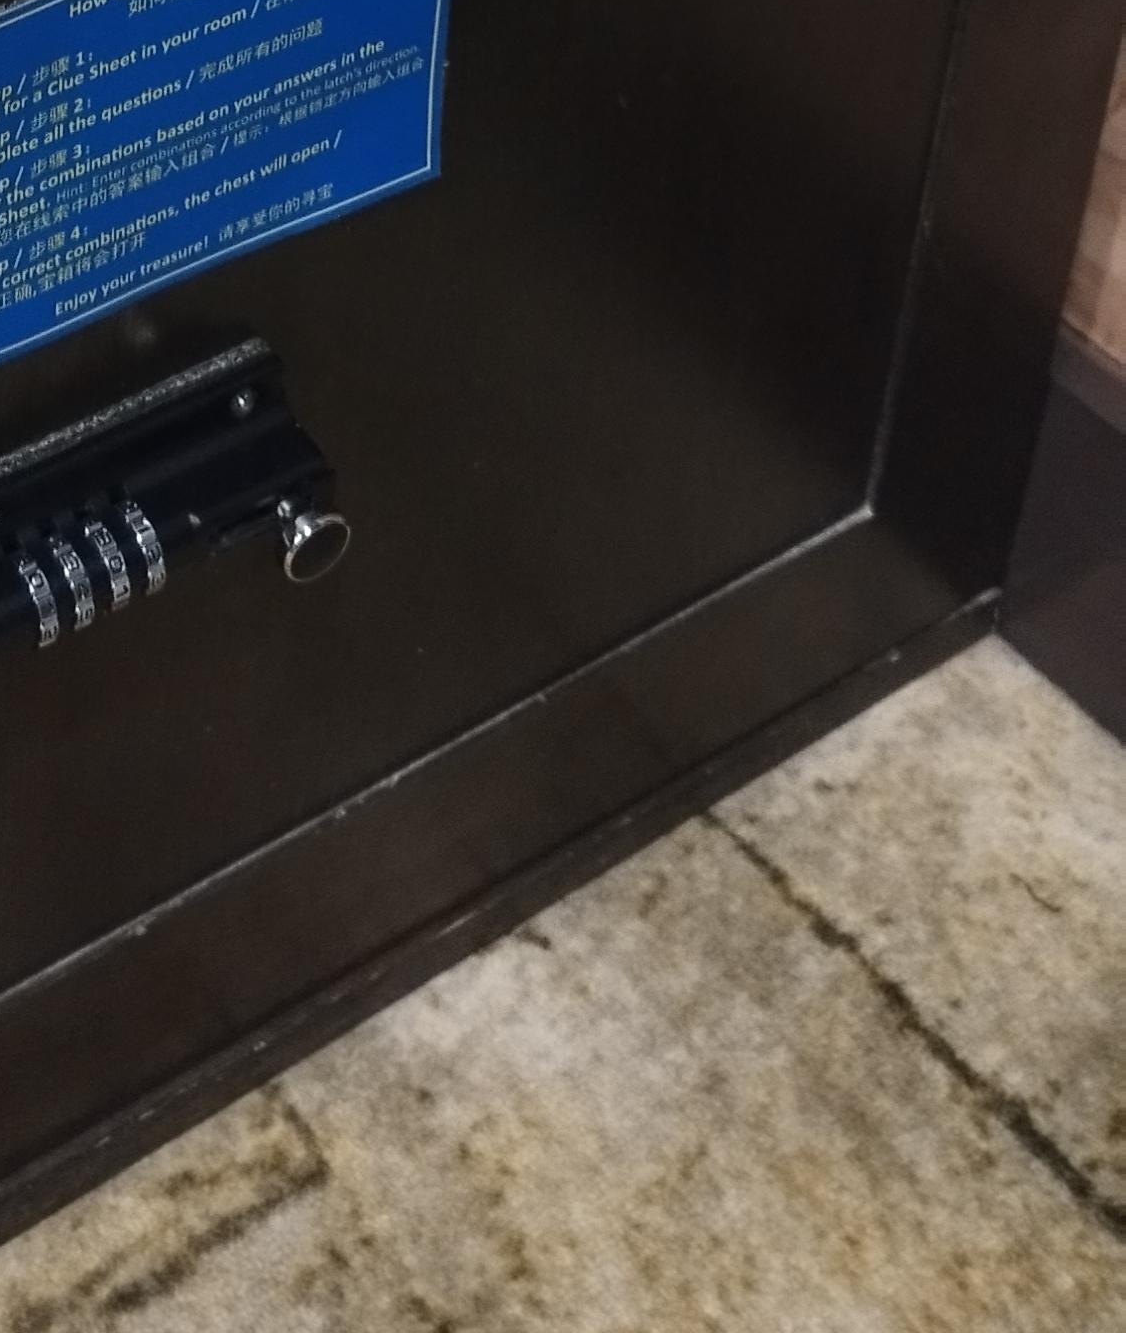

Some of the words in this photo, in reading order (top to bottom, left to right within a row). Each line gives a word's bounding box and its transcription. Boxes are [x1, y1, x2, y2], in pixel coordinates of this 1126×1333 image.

[3, 96, 28, 117] for
[33, 90, 43, 103] a
[47, 73, 84, 96] Clue
[90, 50, 136, 79] Sheet
[142, 43, 156, 60] in
[161, 28, 200, 54] your
[204, 8, 248, 35] room
[44, 124, 64, 145] all
[69, 113, 96, 133] the
[102, 79, 181, 122] questions
[6, 185, 34, 205] the
[40, 135, 152, 192] combinations
[156, 112, 204, 143] based
[208, 104, 229, 121] on
[234, 87, 270, 114] your
[274, 59, 337, 95] answers
[341, 53, 355, 68] in
[360, 40, 385, 59] the
[56, 183, 85, 203] Hint
[92, 166, 126, 188] Enter
[131, 127, 218, 171] combinations
[221, 102, 281, 133] according
[301, 87, 320, 101] the
[2, 254, 61, 289] correct
[66, 206, 179, 261] combinations,
[184, 190, 210, 210] the
[215, 169, 256, 197] chest
[261, 153, 287, 176] will
[292, 139, 330, 163] open
[55, 287, 97, 315] Enjoy
[102, 270, 135, 296] your
[140, 235, 209, 276] treasure!
